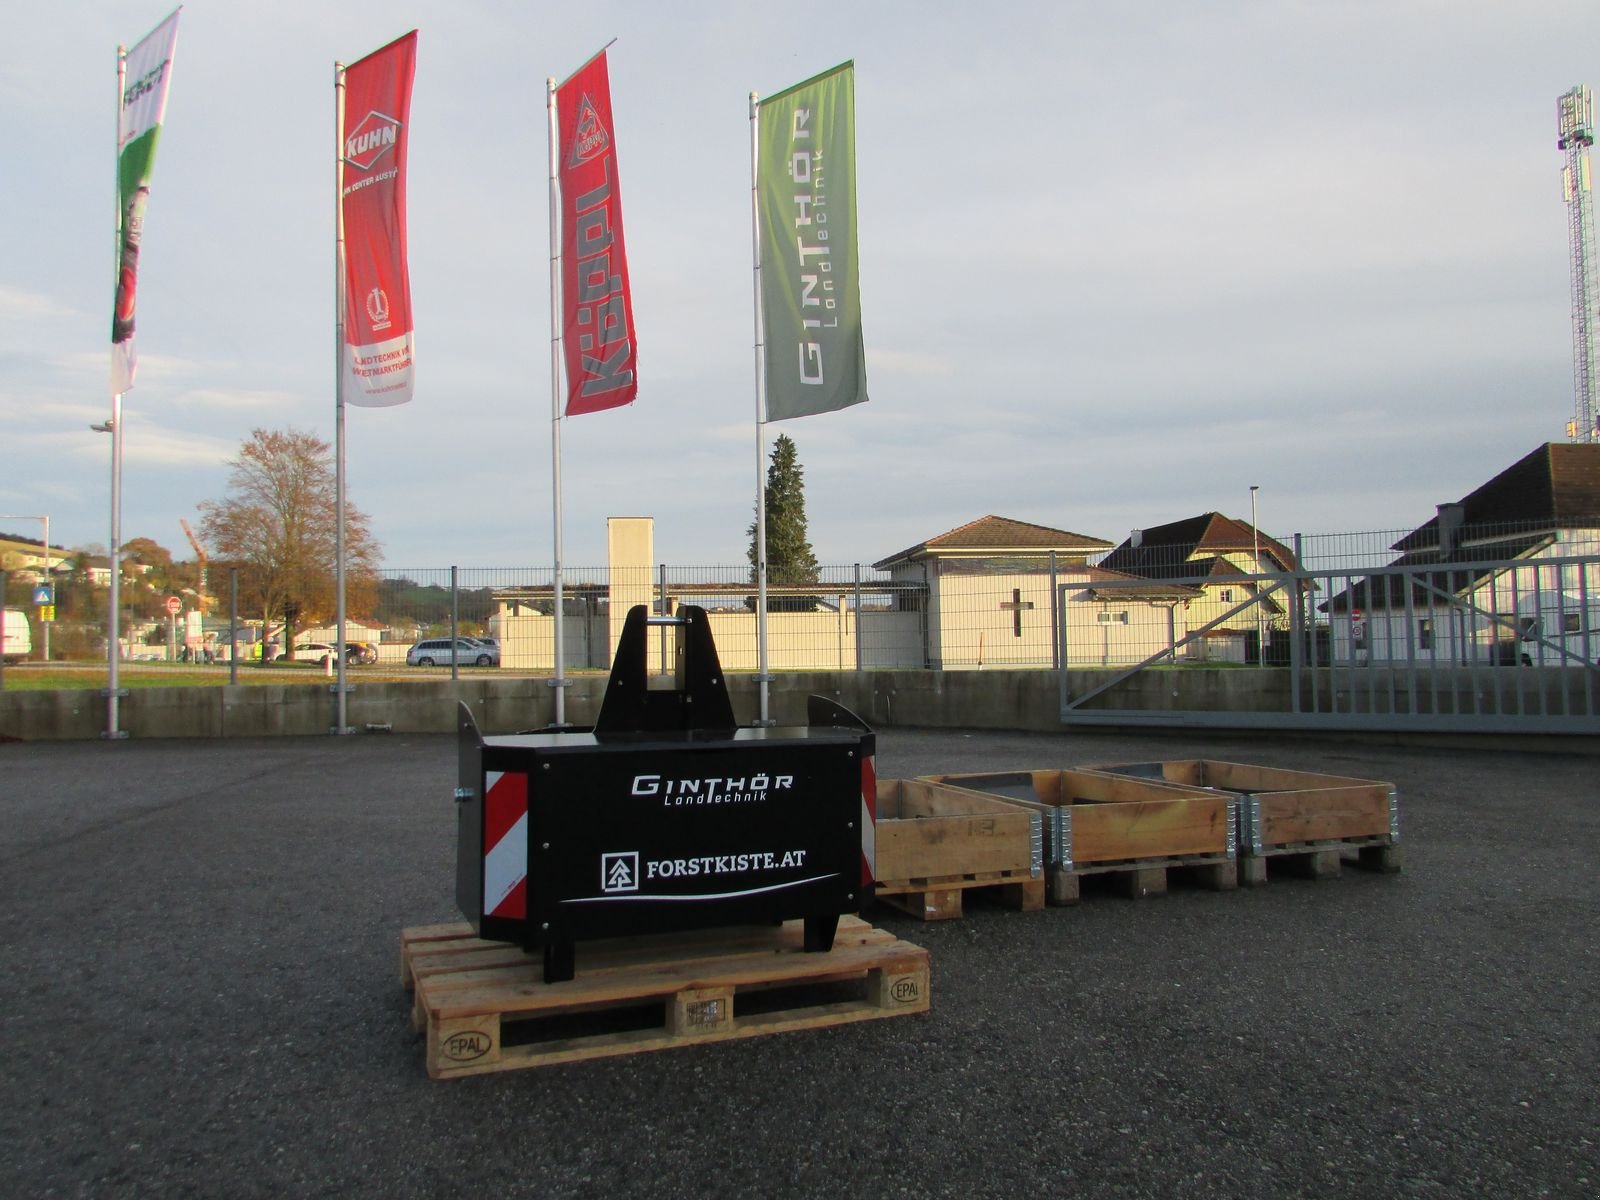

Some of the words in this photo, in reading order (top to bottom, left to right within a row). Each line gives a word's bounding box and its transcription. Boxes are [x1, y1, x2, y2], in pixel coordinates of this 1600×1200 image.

[346, 124, 397, 159] KUHN
[352, 176, 375, 192] CENTER
[788, 108, 830, 385] GINTHÖR
[631, 773, 794, 803] GINTHÖR
[647, 850, 806, 879] FORSTKISTE.AT
[450, 1036, 485, 1057] EPAL
